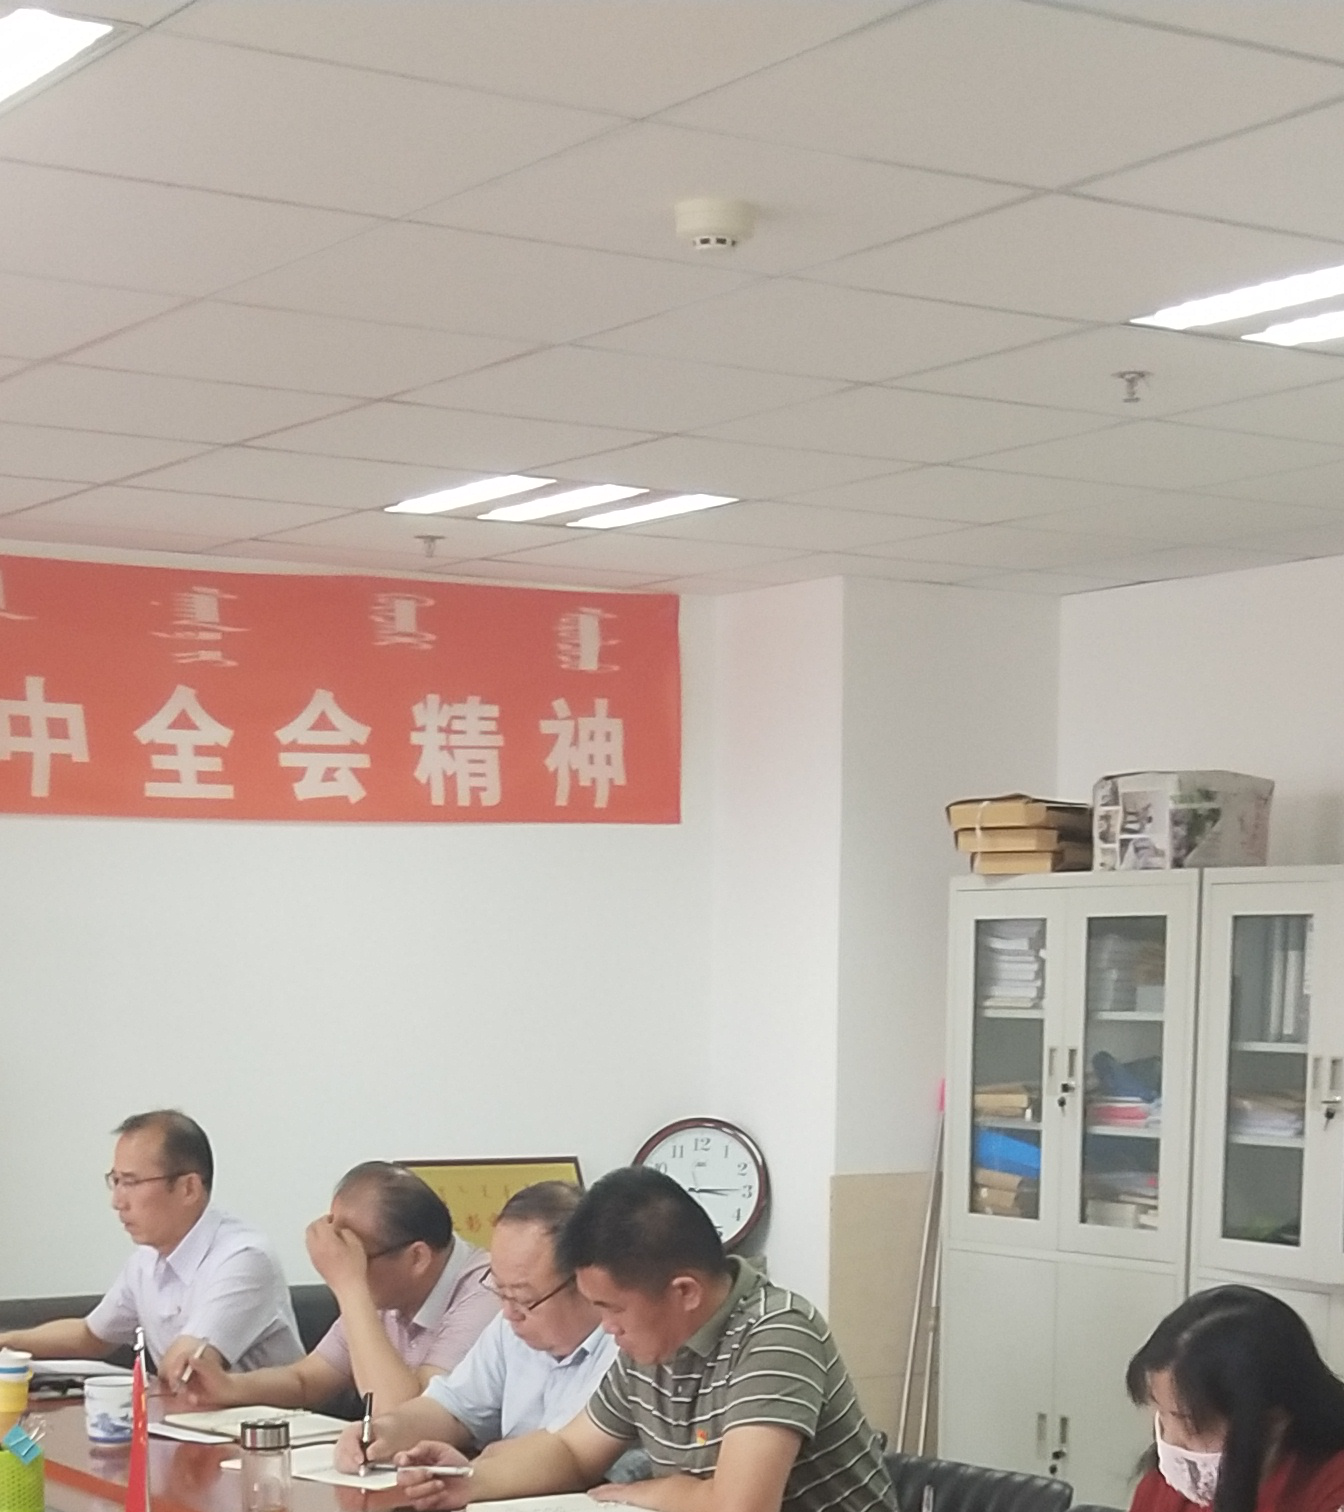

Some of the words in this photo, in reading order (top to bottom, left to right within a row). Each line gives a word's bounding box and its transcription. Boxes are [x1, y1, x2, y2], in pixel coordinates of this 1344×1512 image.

[694, 1137, 711, 1151] 12
[672, 1145, 684, 1158] 11
[737, 1162, 748, 1176] 2
[741, 1184, 753, 1198] 3
[731, 1207, 741, 1221] 4
